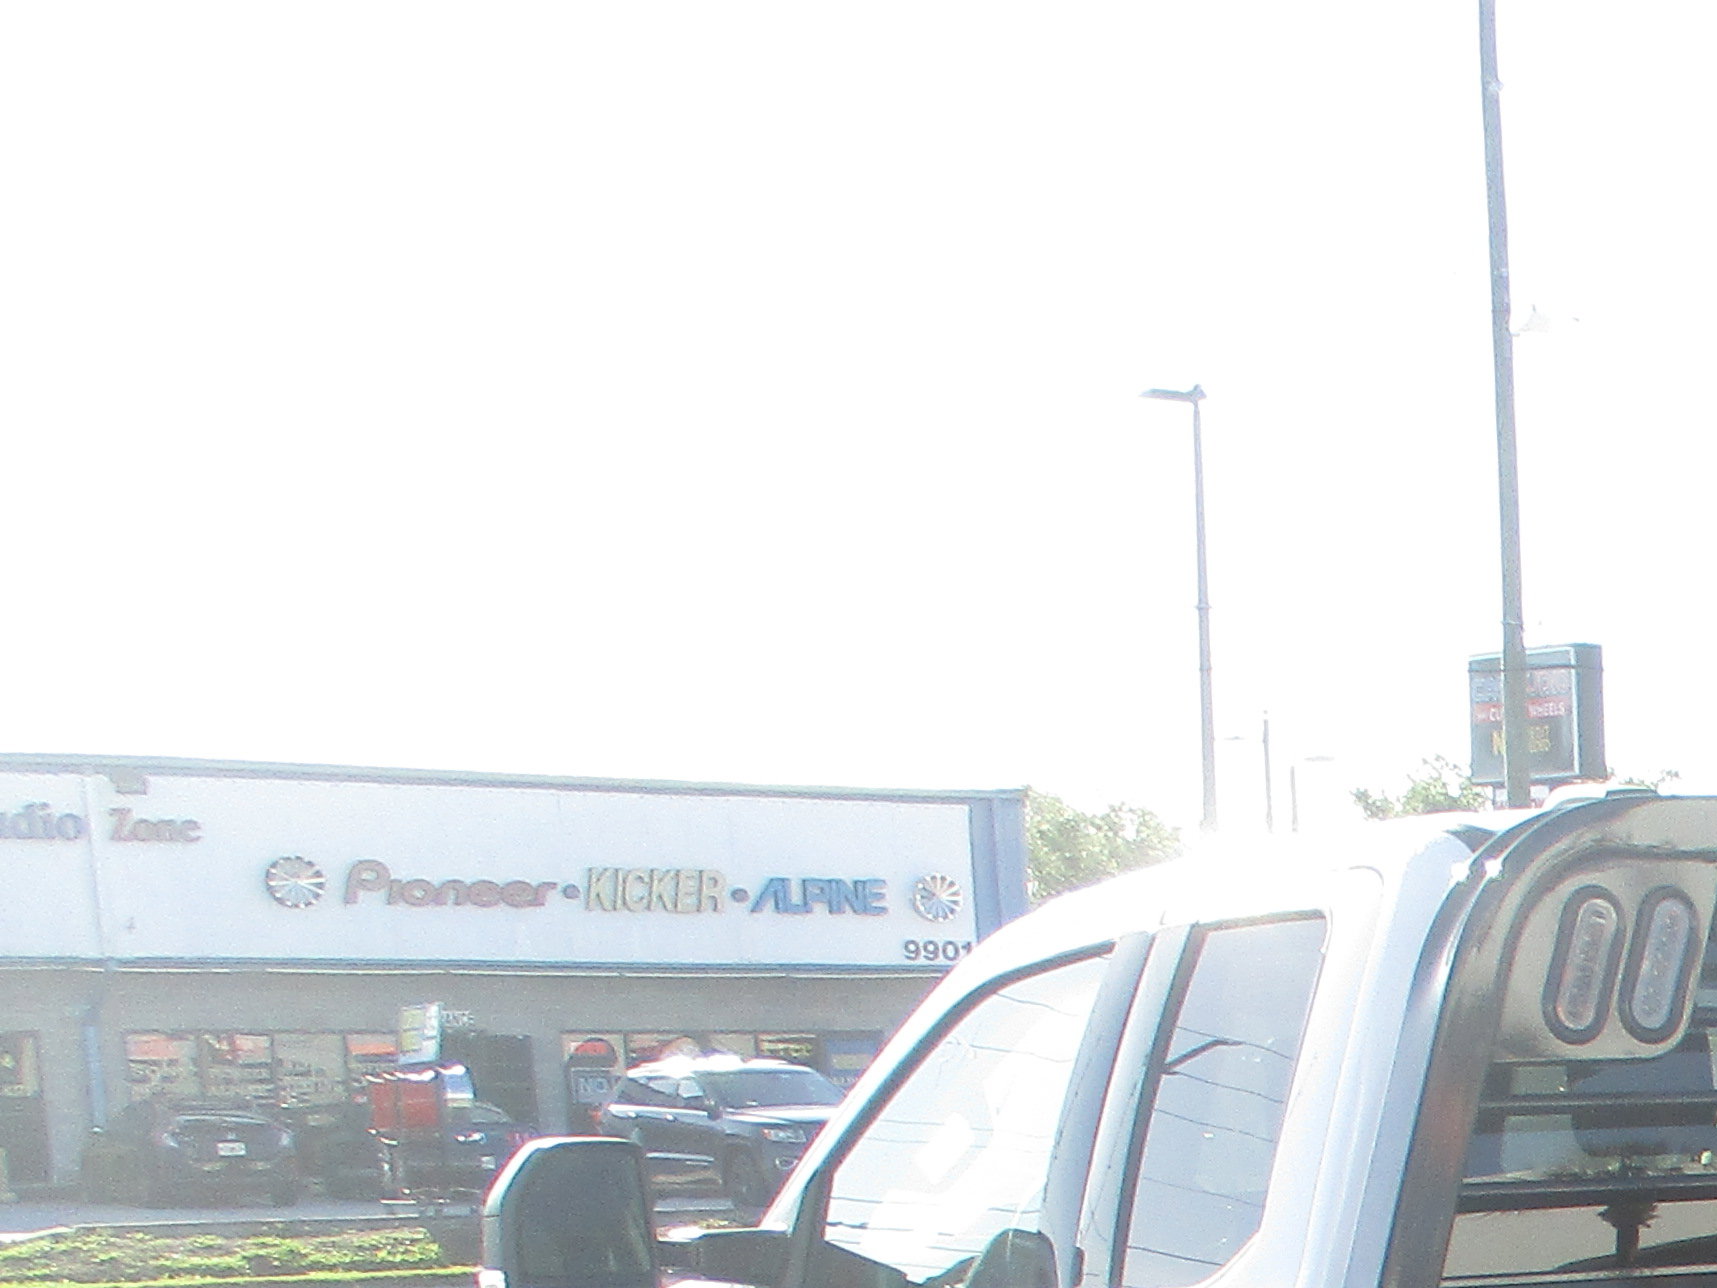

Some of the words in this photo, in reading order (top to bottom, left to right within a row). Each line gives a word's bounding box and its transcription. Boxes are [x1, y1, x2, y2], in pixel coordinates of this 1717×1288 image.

[109, 808, 202, 843] Zone
[344, 859, 558, 908] Pioneer
[585, 866, 727, 914] KICKER
[750, 876, 889, 916] ALPINE
[904, 939, 974, 961] 9901
